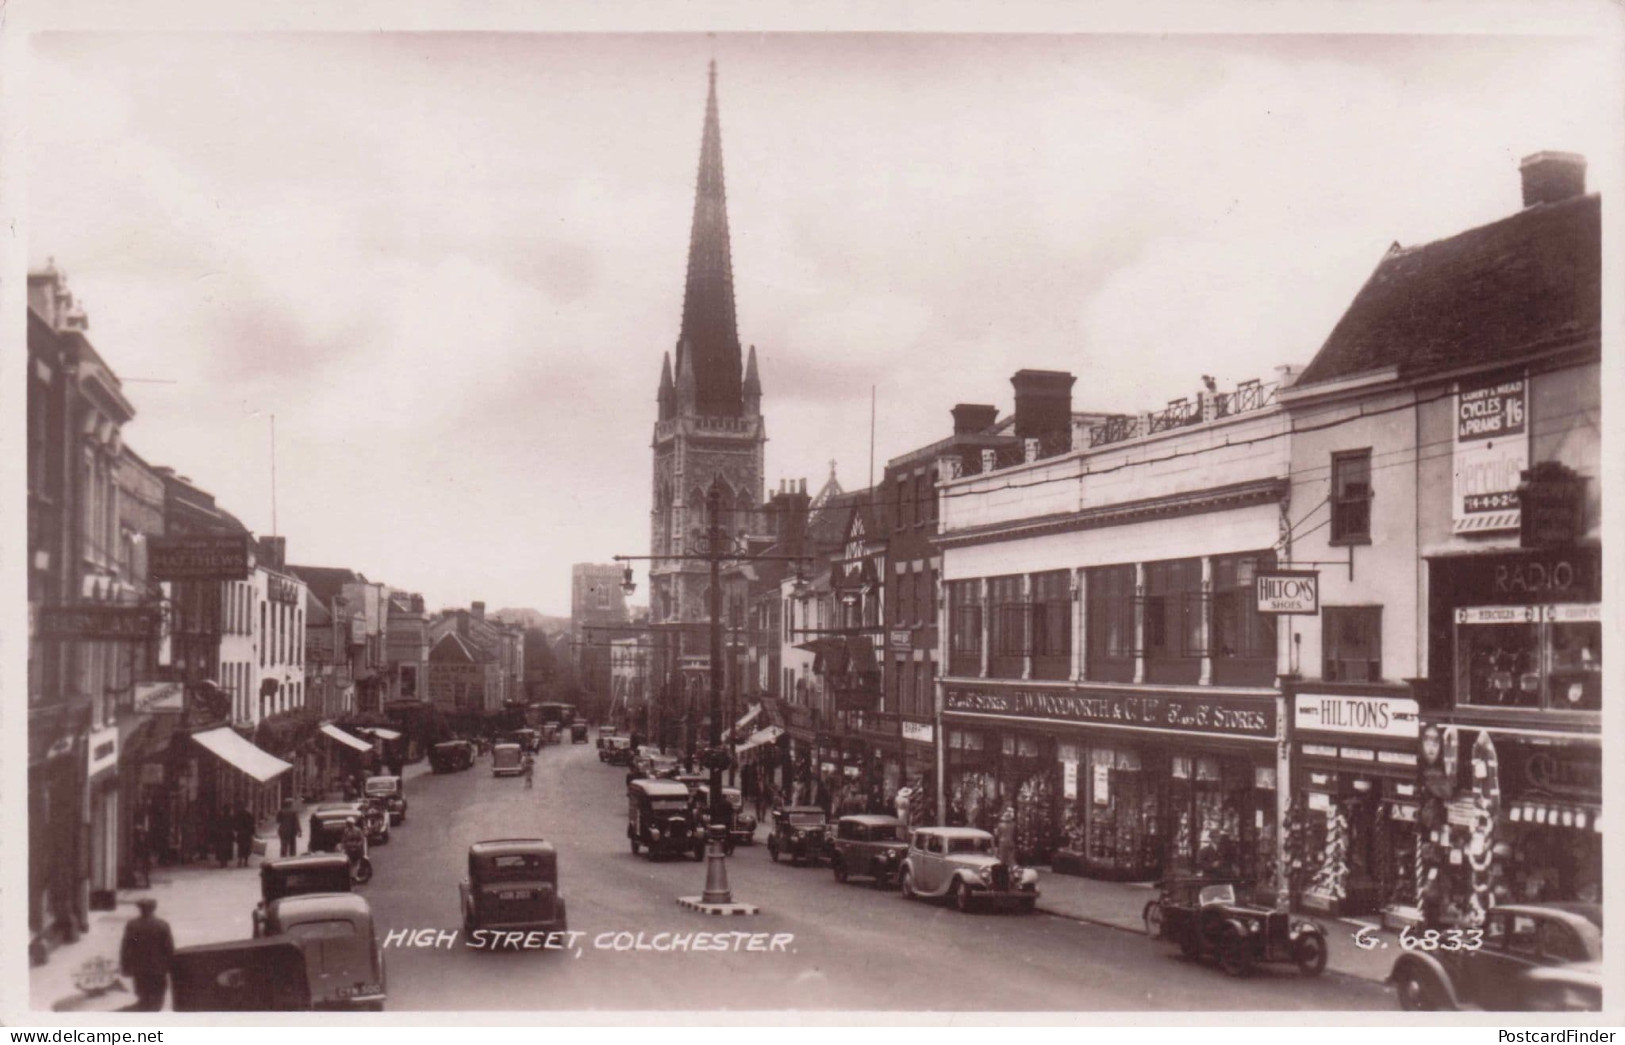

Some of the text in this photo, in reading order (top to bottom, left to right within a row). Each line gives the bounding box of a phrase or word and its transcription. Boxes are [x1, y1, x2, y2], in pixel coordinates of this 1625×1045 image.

[1461, 397, 1501, 419] CYCLES
[1466, 415, 1501, 434] PRAMS
[1495, 561, 1573, 591] RADIO
[1260, 578, 1314, 601] HILTONS
[1272, 601, 1302, 609] SHOES
[1112, 703, 1121, 719] &
[1321, 699, 1389, 729] HILTONS
